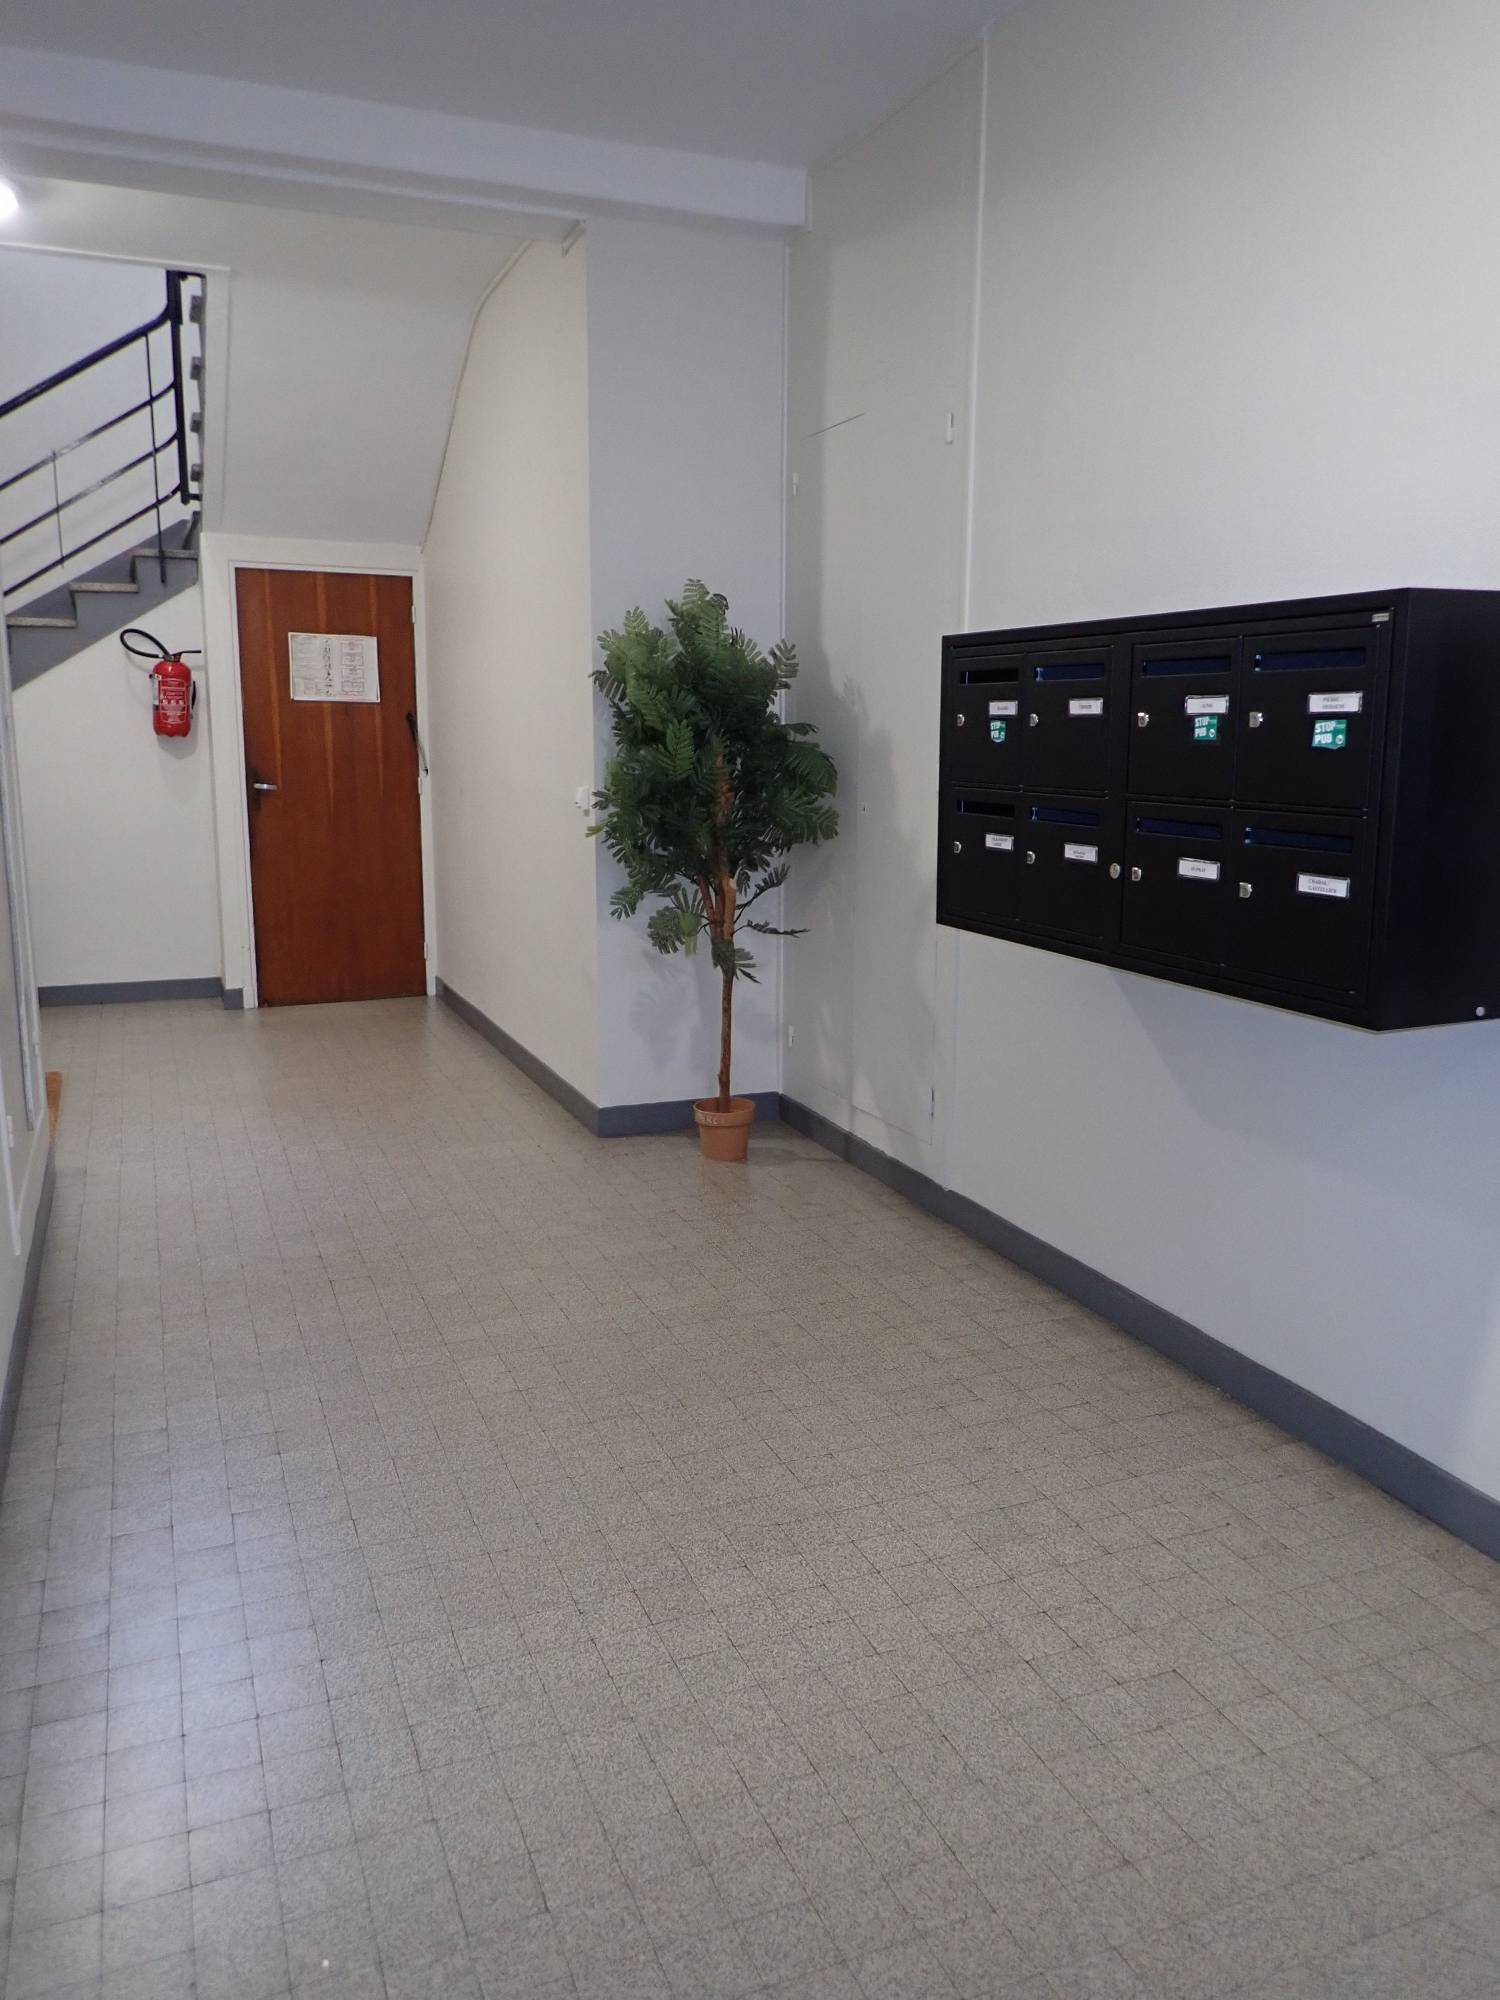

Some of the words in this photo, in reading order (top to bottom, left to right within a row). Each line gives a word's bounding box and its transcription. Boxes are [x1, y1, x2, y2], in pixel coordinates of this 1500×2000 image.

[1195, 717, 1209, 727] STOP
[1315, 721, 1336, 733] STOP
[1195, 727, 1207, 737] PUB
[1314, 733, 1332, 744] PUB
